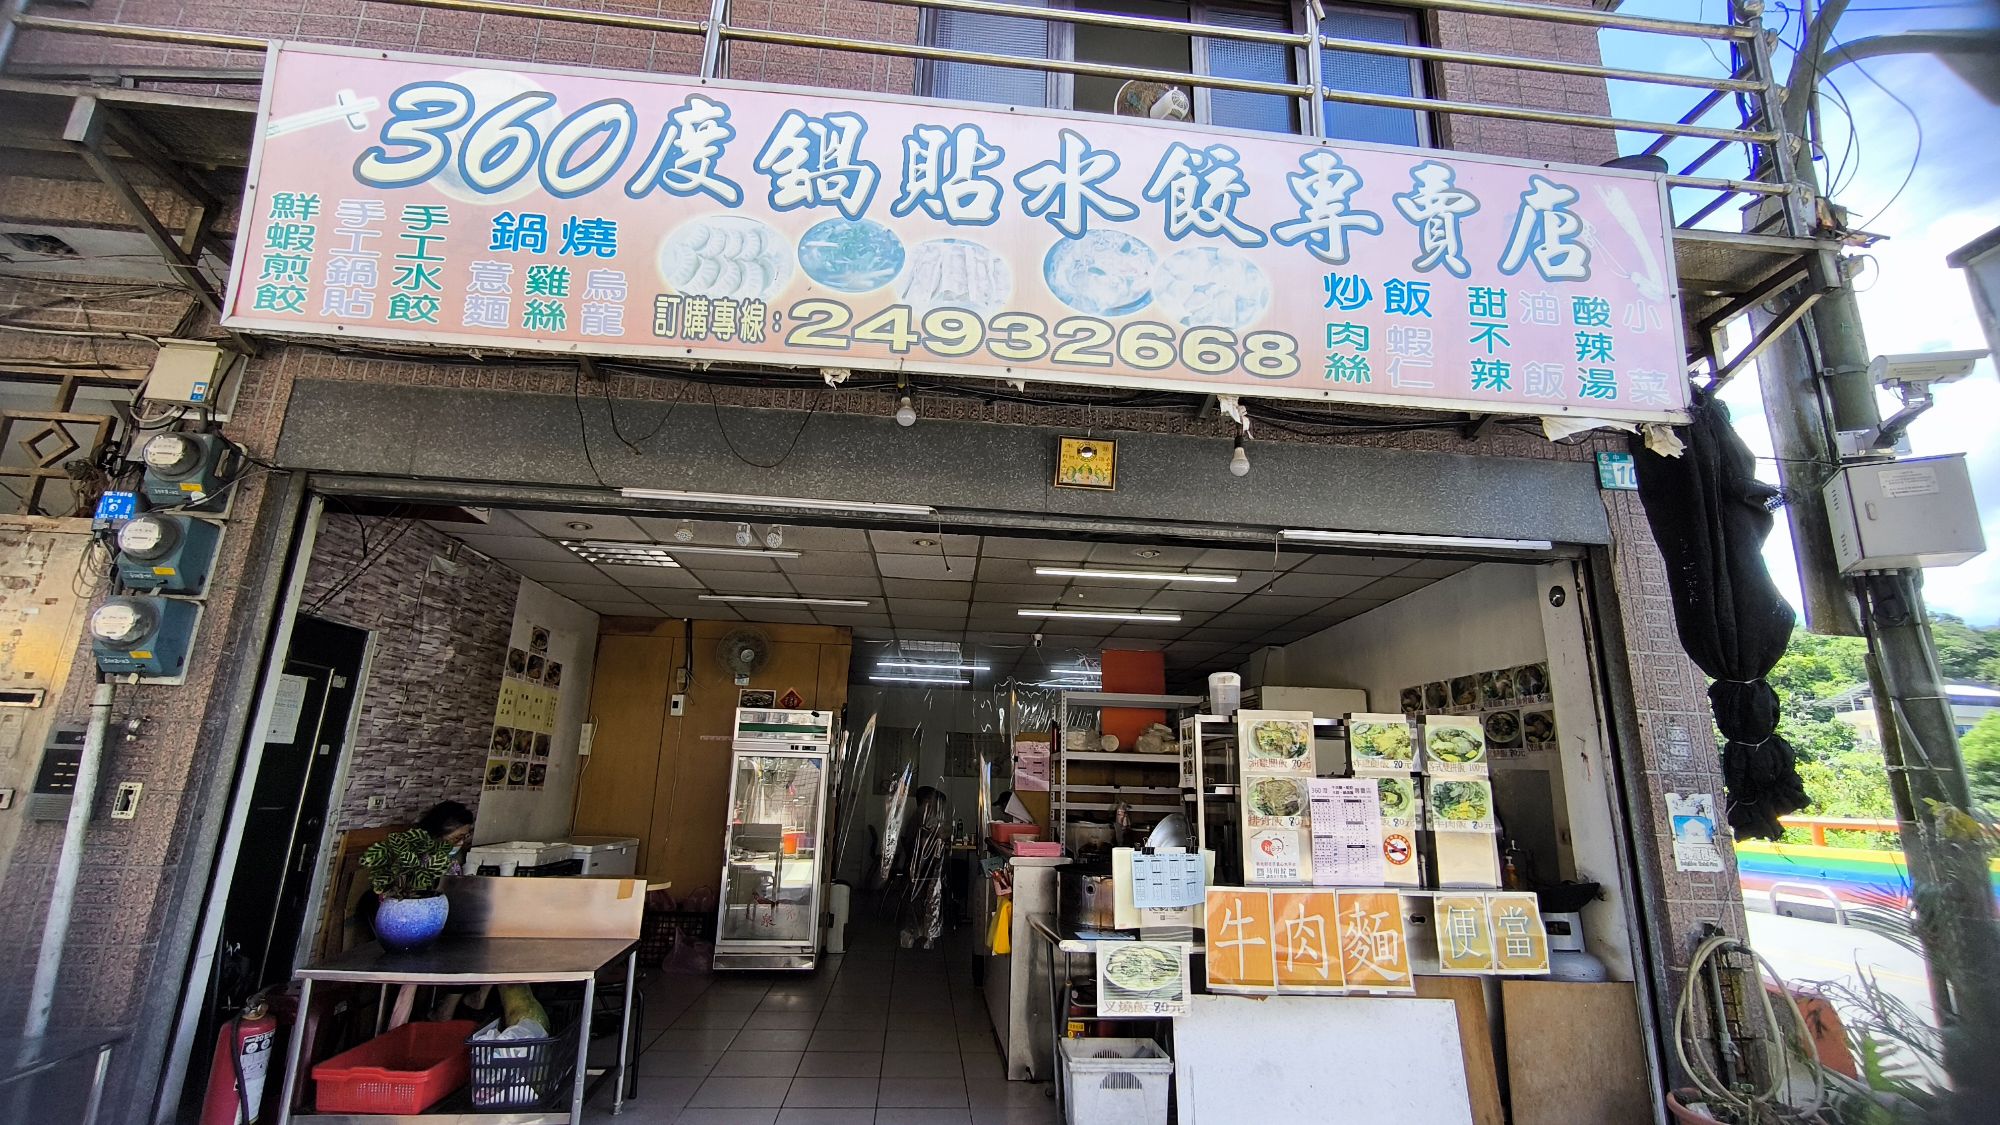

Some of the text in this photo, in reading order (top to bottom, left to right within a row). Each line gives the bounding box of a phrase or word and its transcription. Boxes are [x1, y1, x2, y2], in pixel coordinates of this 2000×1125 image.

[353, 81, 1592, 281] 360度鍋貼水餃專賣店
[253, 192, 321, 314] 鮮蝦煎餃
[321, 199, 385, 319] 手工鍋貼
[387, 204, 449, 325] 手工水餃
[488, 210, 619, 259] 鍋燒
[462, 260, 515, 329] 意麵
[522, 264, 571, 332] 雞絲
[580, 269, 628, 337] 烏龍
[1323, 272, 1432, 318] 炒飯
[784, 298, 1301, 379] 24932668
[1325, 321, 1372, 385] 肉絲
[1385, 326, 1434, 390] 蝦仁
[1468, 286, 1513, 393] 甜不辣
[1571, 295, 1618, 400] 酸辣湯
[1215, 897, 1406, 981] 牛肉麵
[1445, 904, 1531, 960] 便當
